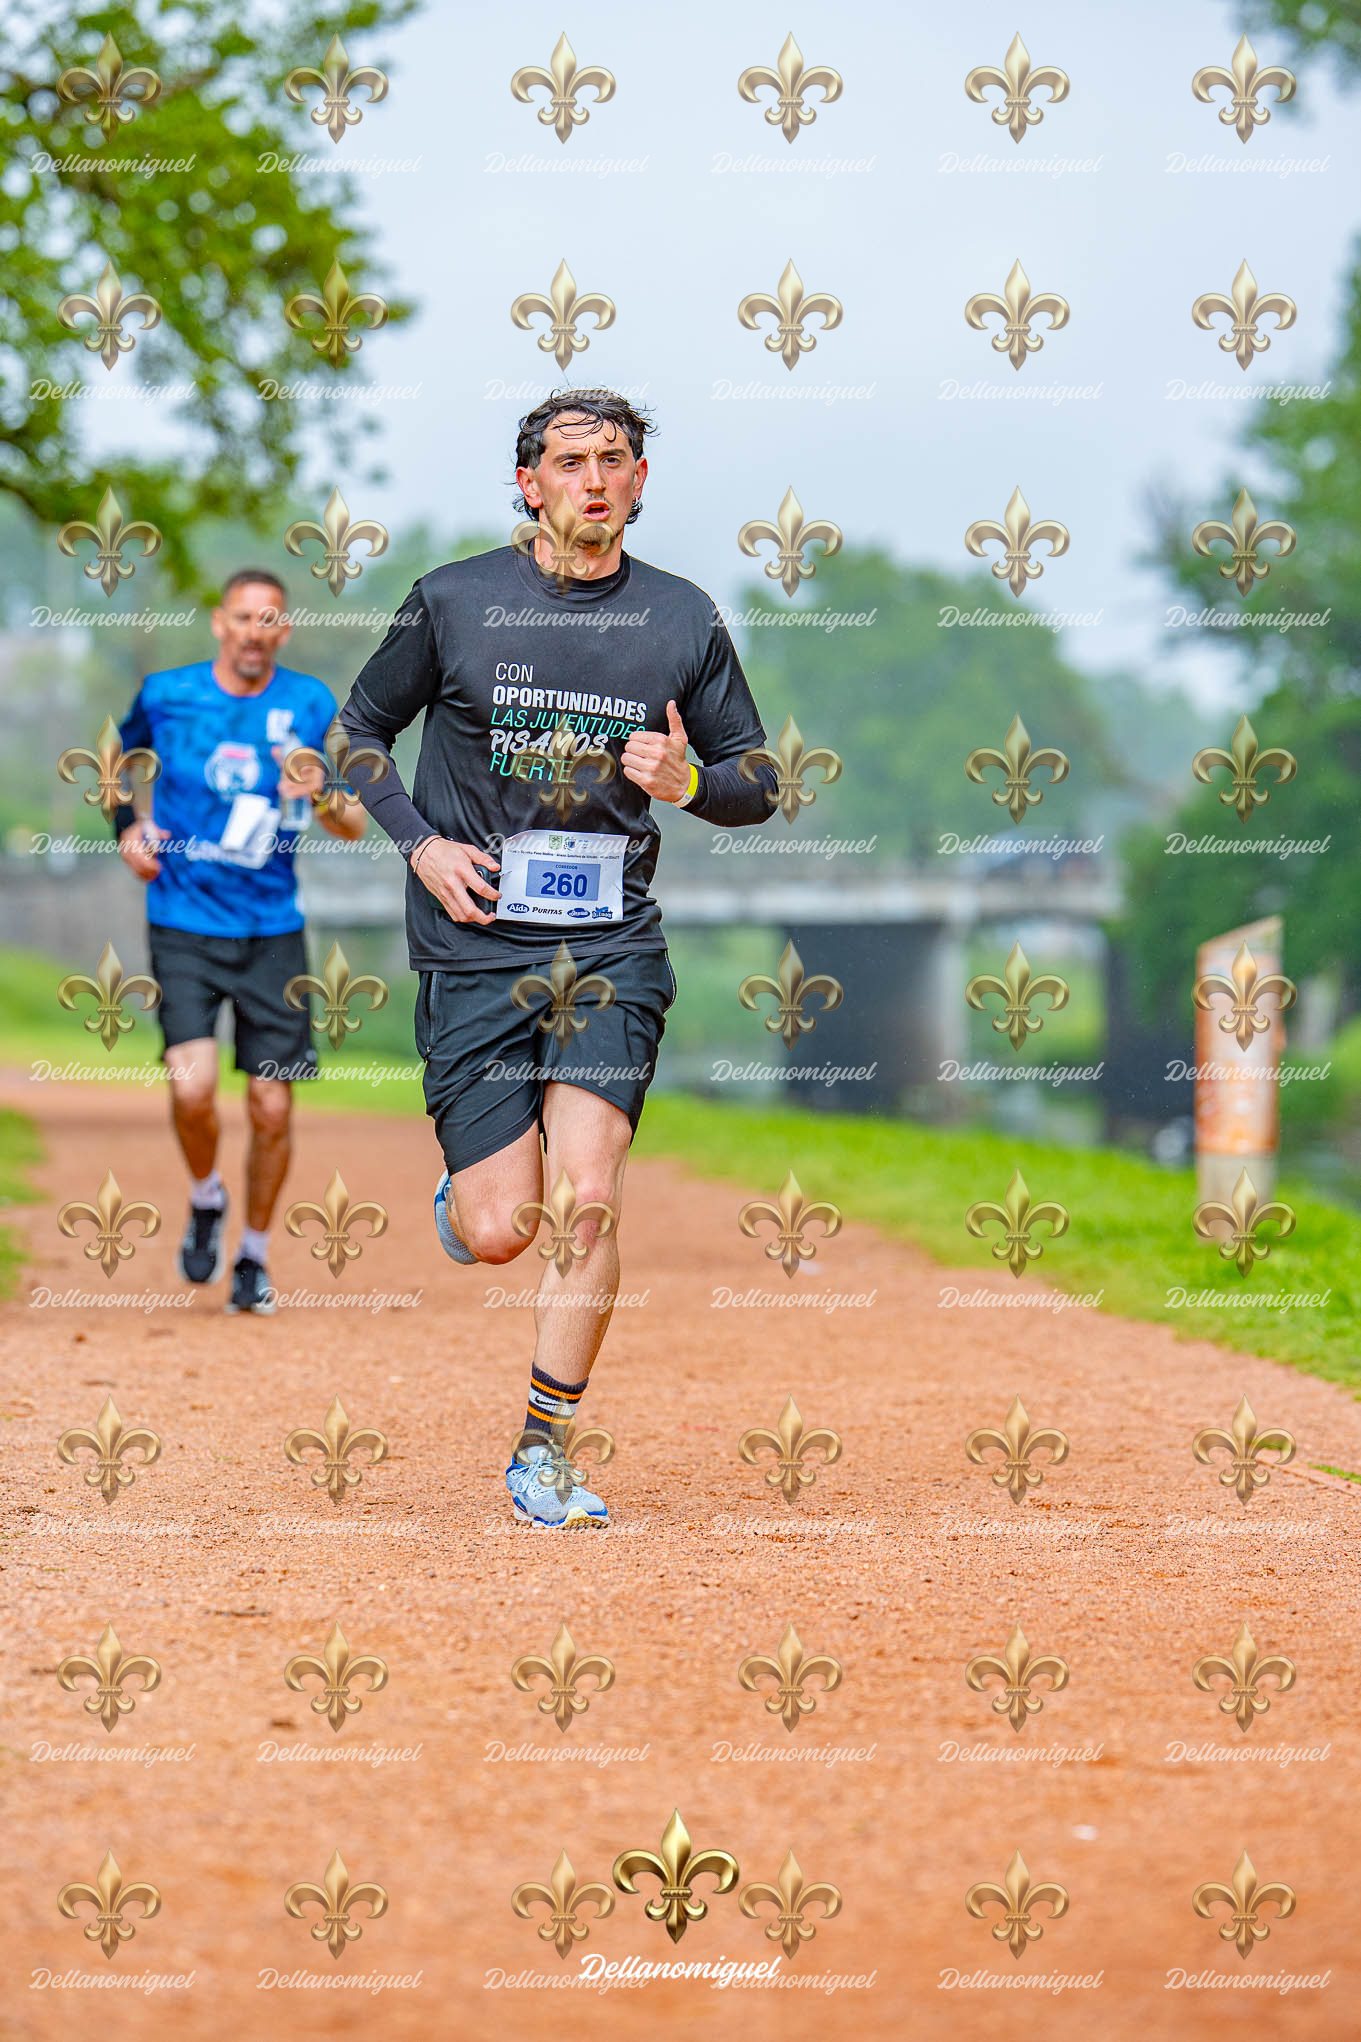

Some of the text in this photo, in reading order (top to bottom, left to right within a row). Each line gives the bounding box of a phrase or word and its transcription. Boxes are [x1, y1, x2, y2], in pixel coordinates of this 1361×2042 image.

[495, 662, 534, 683] CON
[492, 685, 648, 723] OPORTUNIDADES
[490, 707, 528, 728] LAS
[489, 729, 609, 757] PISAMOS
[489, 752, 575, 784] FUERTE
[540, 872, 588, 898] 260
[532, 906, 563, 916] PURITAS
